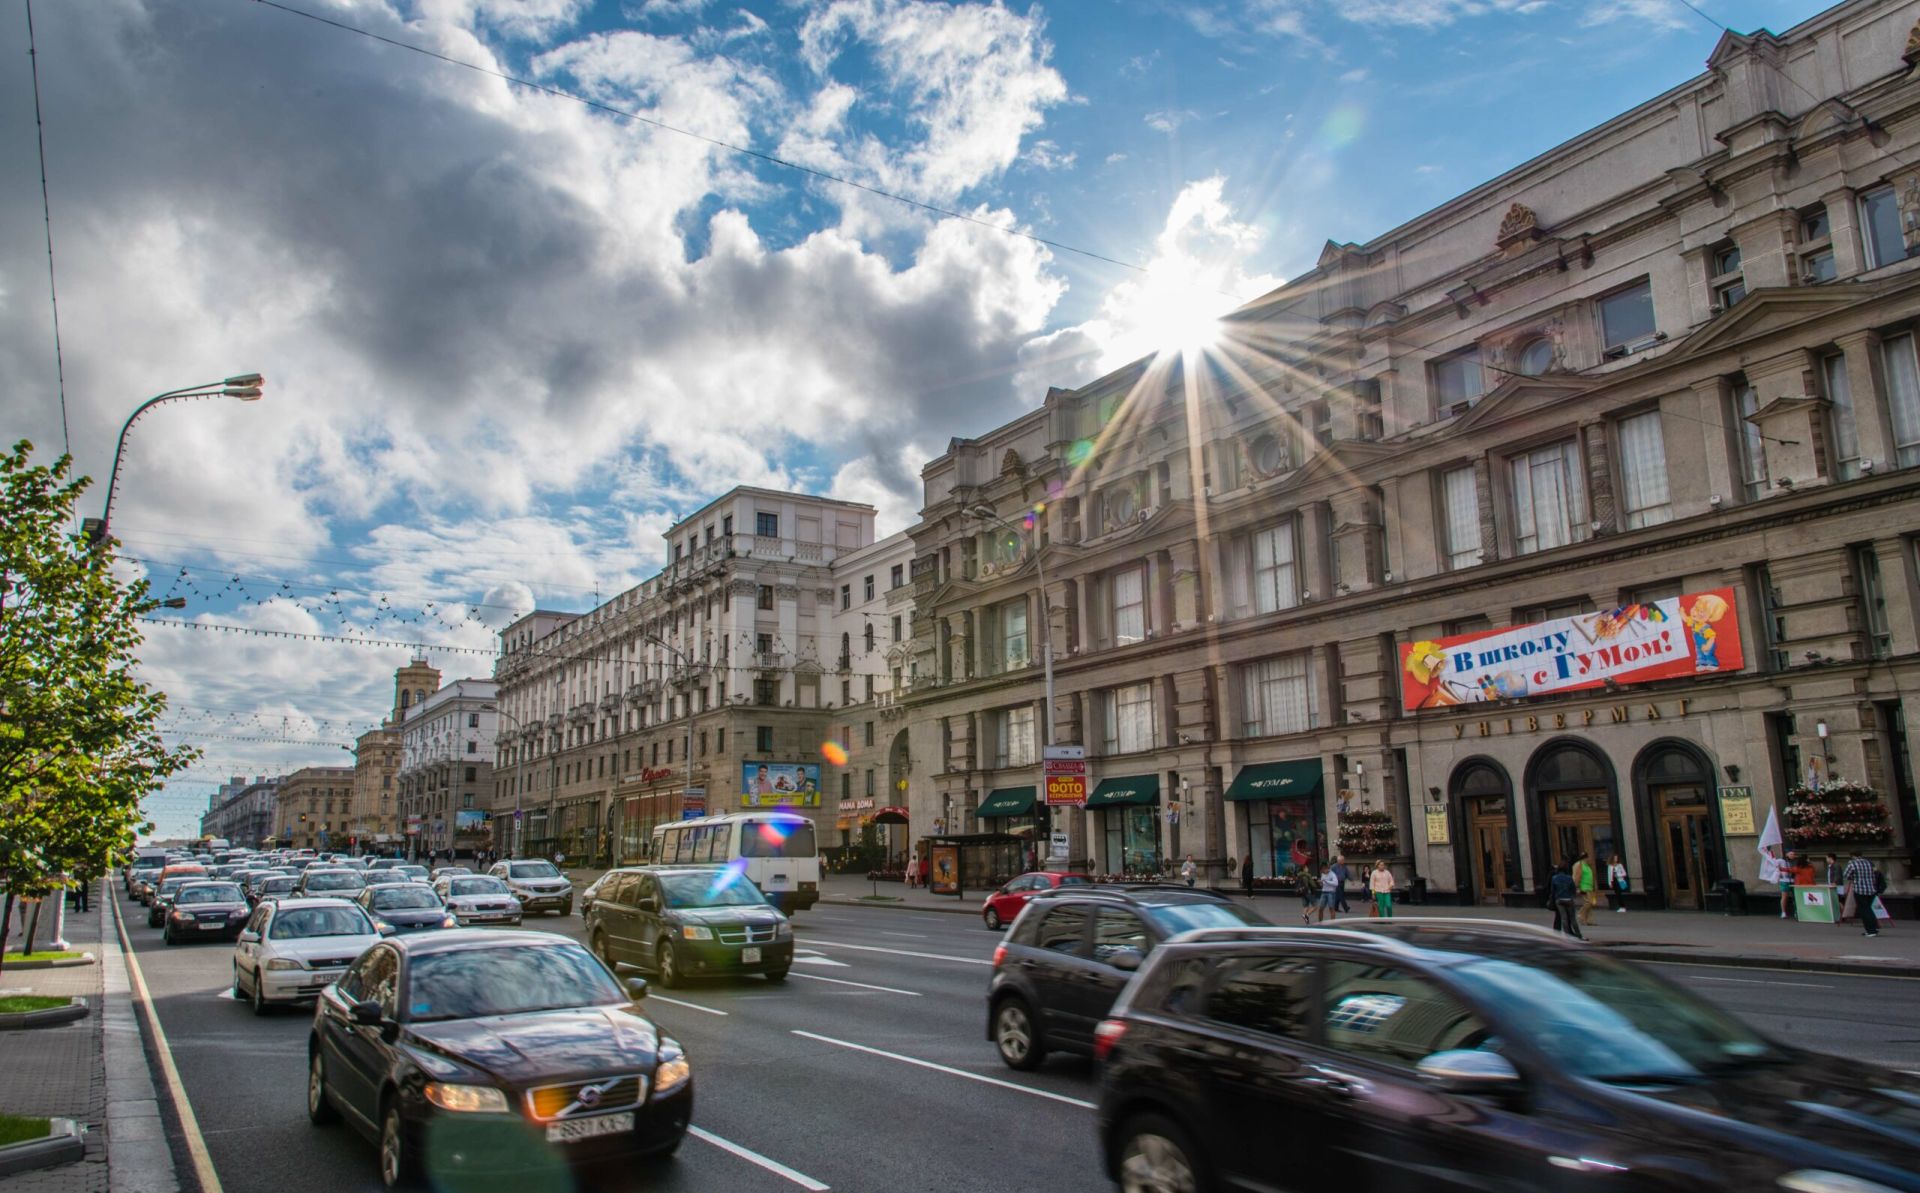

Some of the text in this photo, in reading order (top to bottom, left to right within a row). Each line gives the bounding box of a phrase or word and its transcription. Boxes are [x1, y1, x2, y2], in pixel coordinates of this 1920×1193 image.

[1452, 630, 1570, 673] В школу
[1533, 670, 1548, 686] с
[1454, 699, 1692, 740] УНІВЕРМАГ
[1049, 782, 1084, 793] ФОТО
[1722, 788, 1748, 797] ГУМ
[838, 799, 874, 810] МАМА ДОМА
